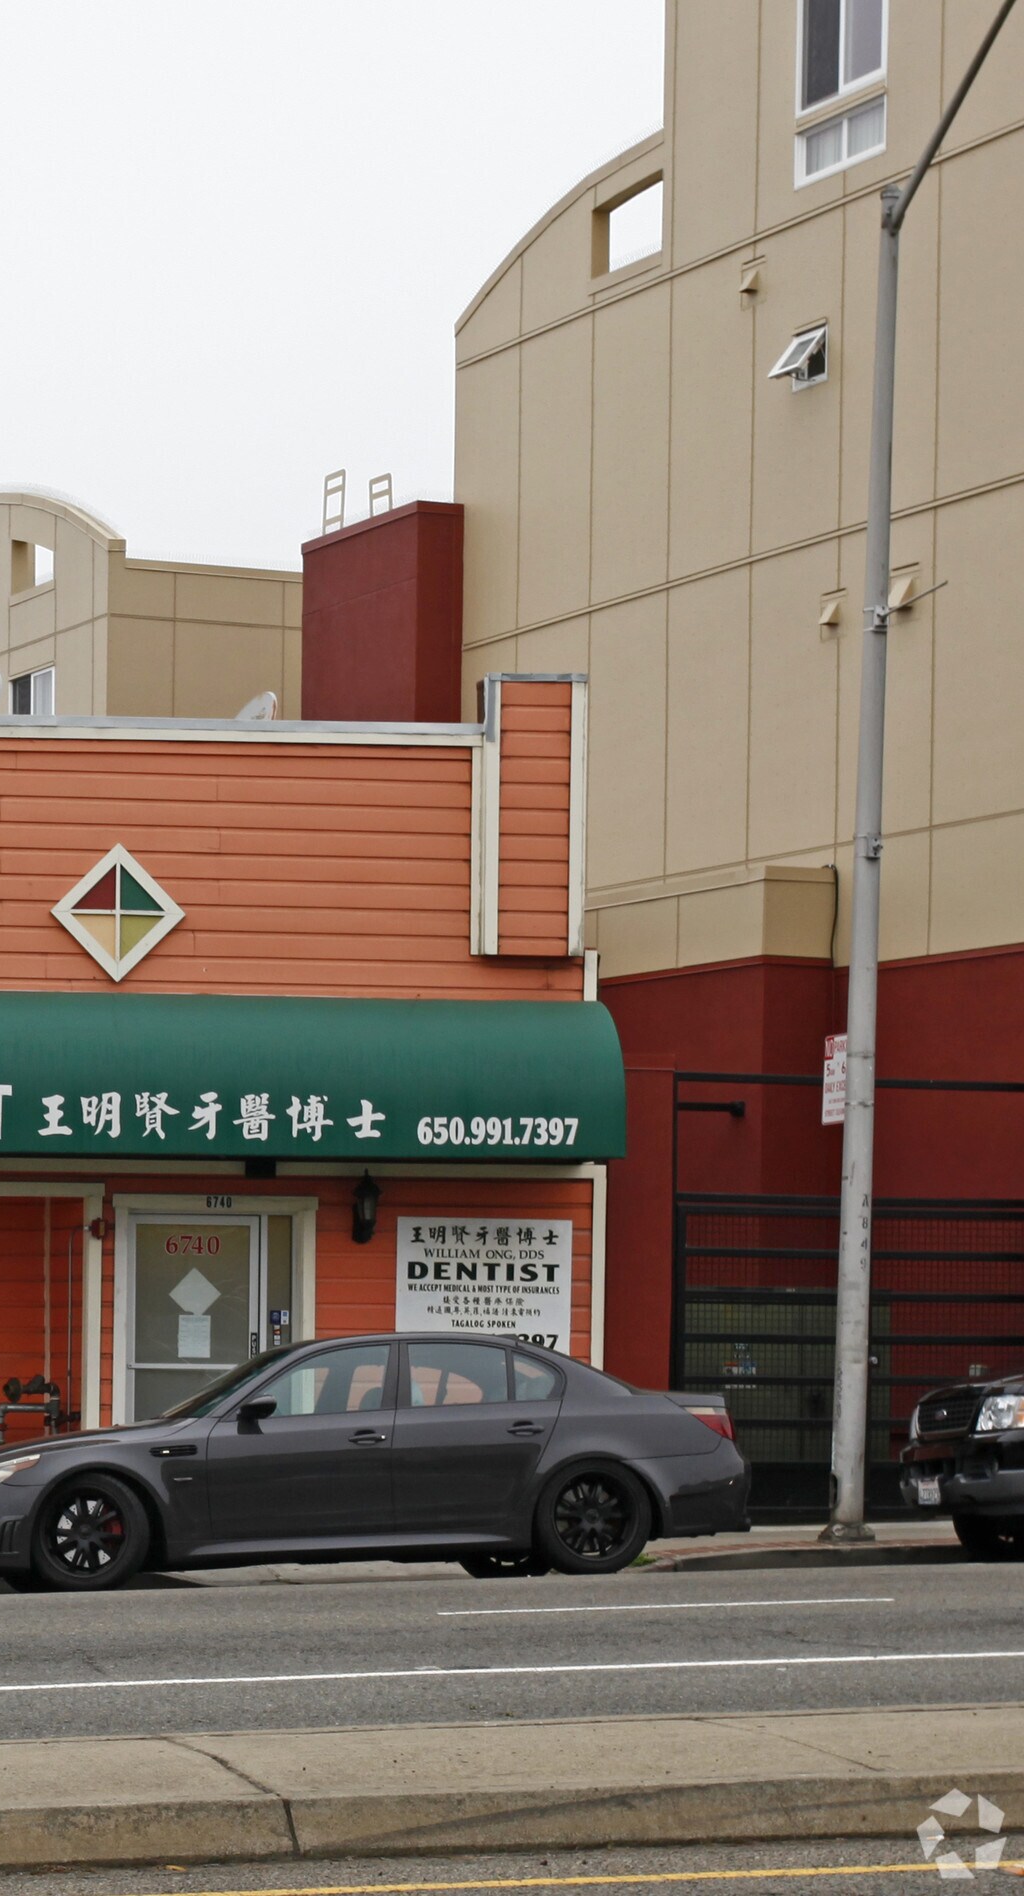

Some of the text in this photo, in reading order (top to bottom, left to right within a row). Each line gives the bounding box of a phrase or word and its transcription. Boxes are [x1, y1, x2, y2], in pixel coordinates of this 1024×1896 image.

[38, 1091, 387, 1142] 王明賢牙醫博士
[416, 1116, 579, 1147] 650.991.7397
[206, 1196, 233, 1208] 6740
[165, 1235, 222, 1256] 6740
[410, 1225, 560, 1247] 王明賢牙醫博士
[424, 1248, 545, 1261] WILLIAM ONG, DDS
[407, 1261, 560, 1282] DENTIST
[419, 1283, 442, 1292] ACCEPT
[444, 1284, 470, 1292] MEDICAL
[478, 1285, 494, 1293] MOST
[496, 1285, 511, 1294] TYPE
[512, 1286, 520, 1294] OF
[521, 1286, 560, 1295] INSURANCES
[451, 1319, 516, 1329] TAGALOG SPOKEN
